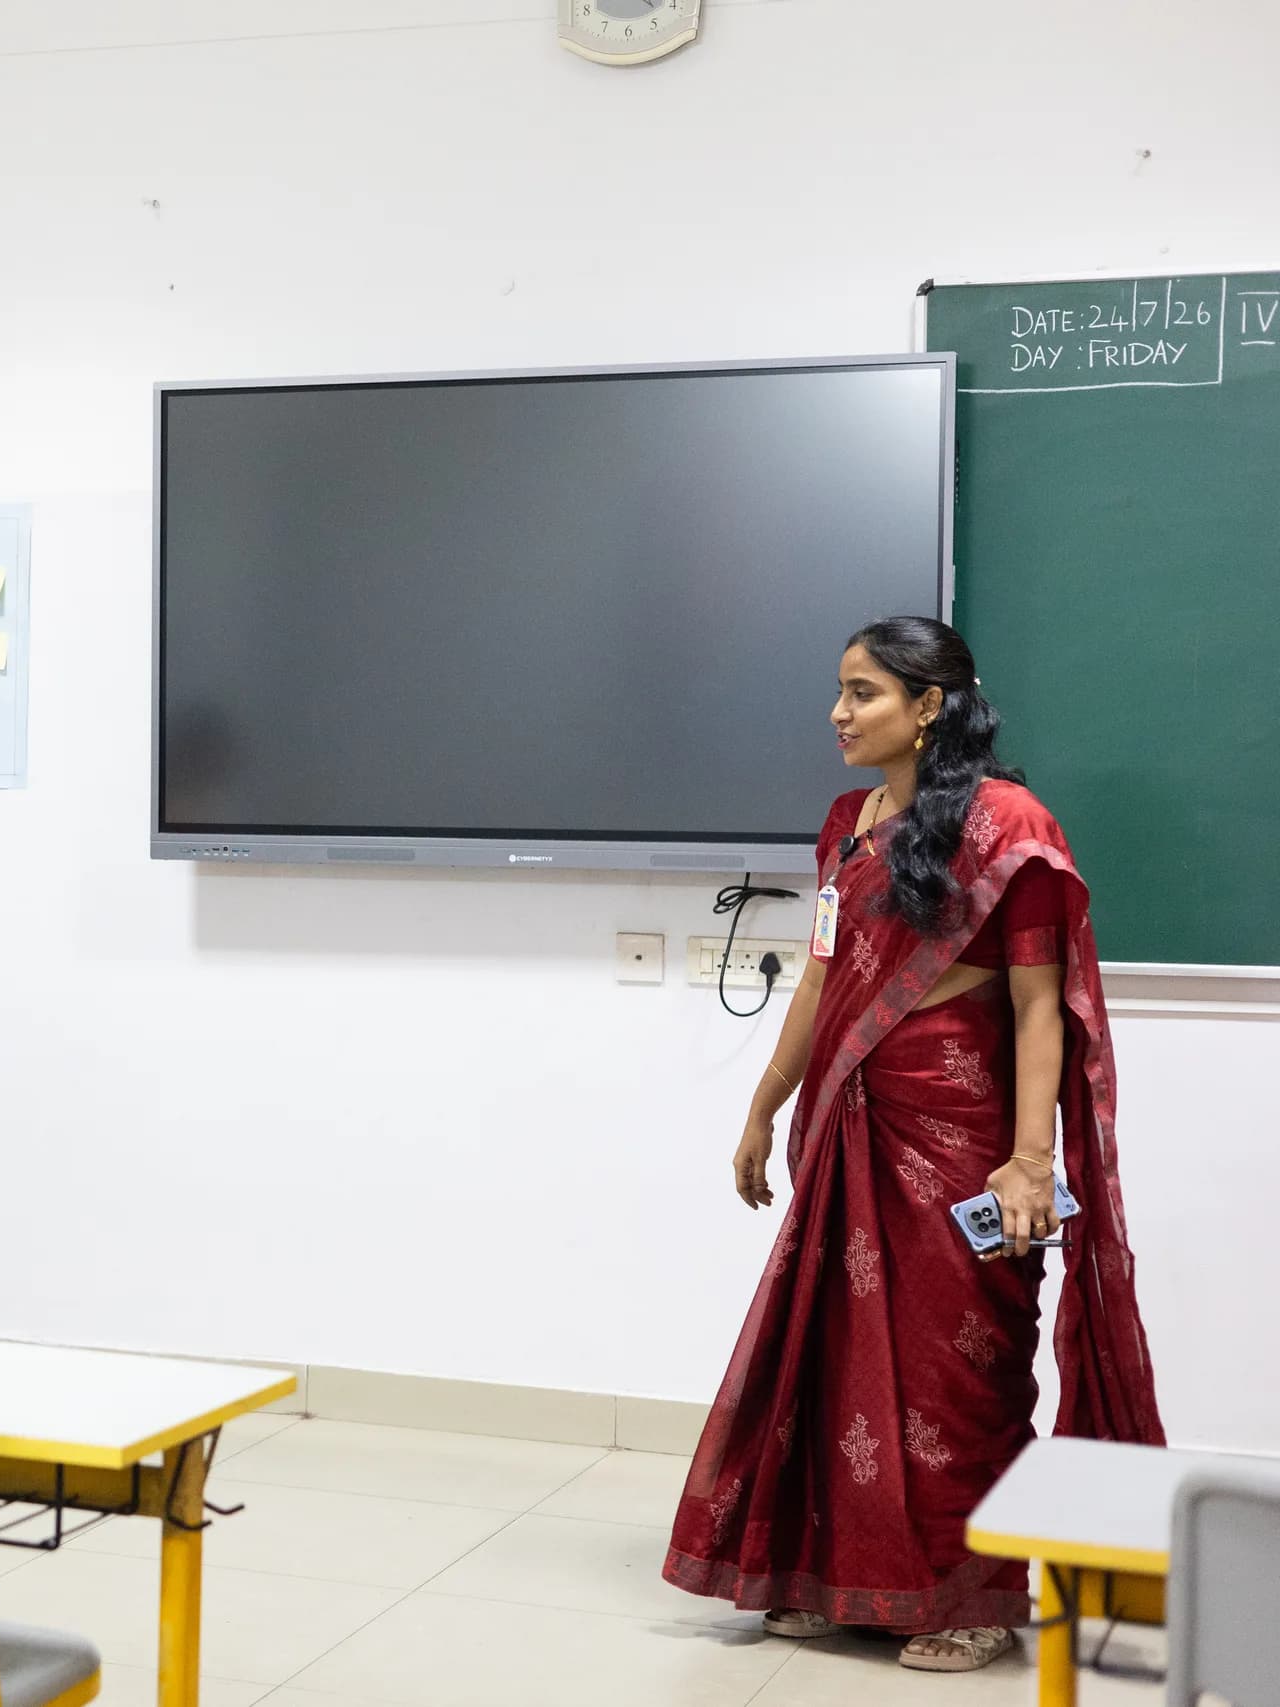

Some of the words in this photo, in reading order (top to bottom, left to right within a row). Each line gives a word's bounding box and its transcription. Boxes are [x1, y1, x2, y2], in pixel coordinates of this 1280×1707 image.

[583, 4, 591, 16] 8
[601, 21, 609, 33] 7
[649, 18, 658, 31] 5
[624, 25, 633, 37] 6
[1241, 299, 1280, 335] IV
[1088, 339, 1188, 369] FRIDAY
